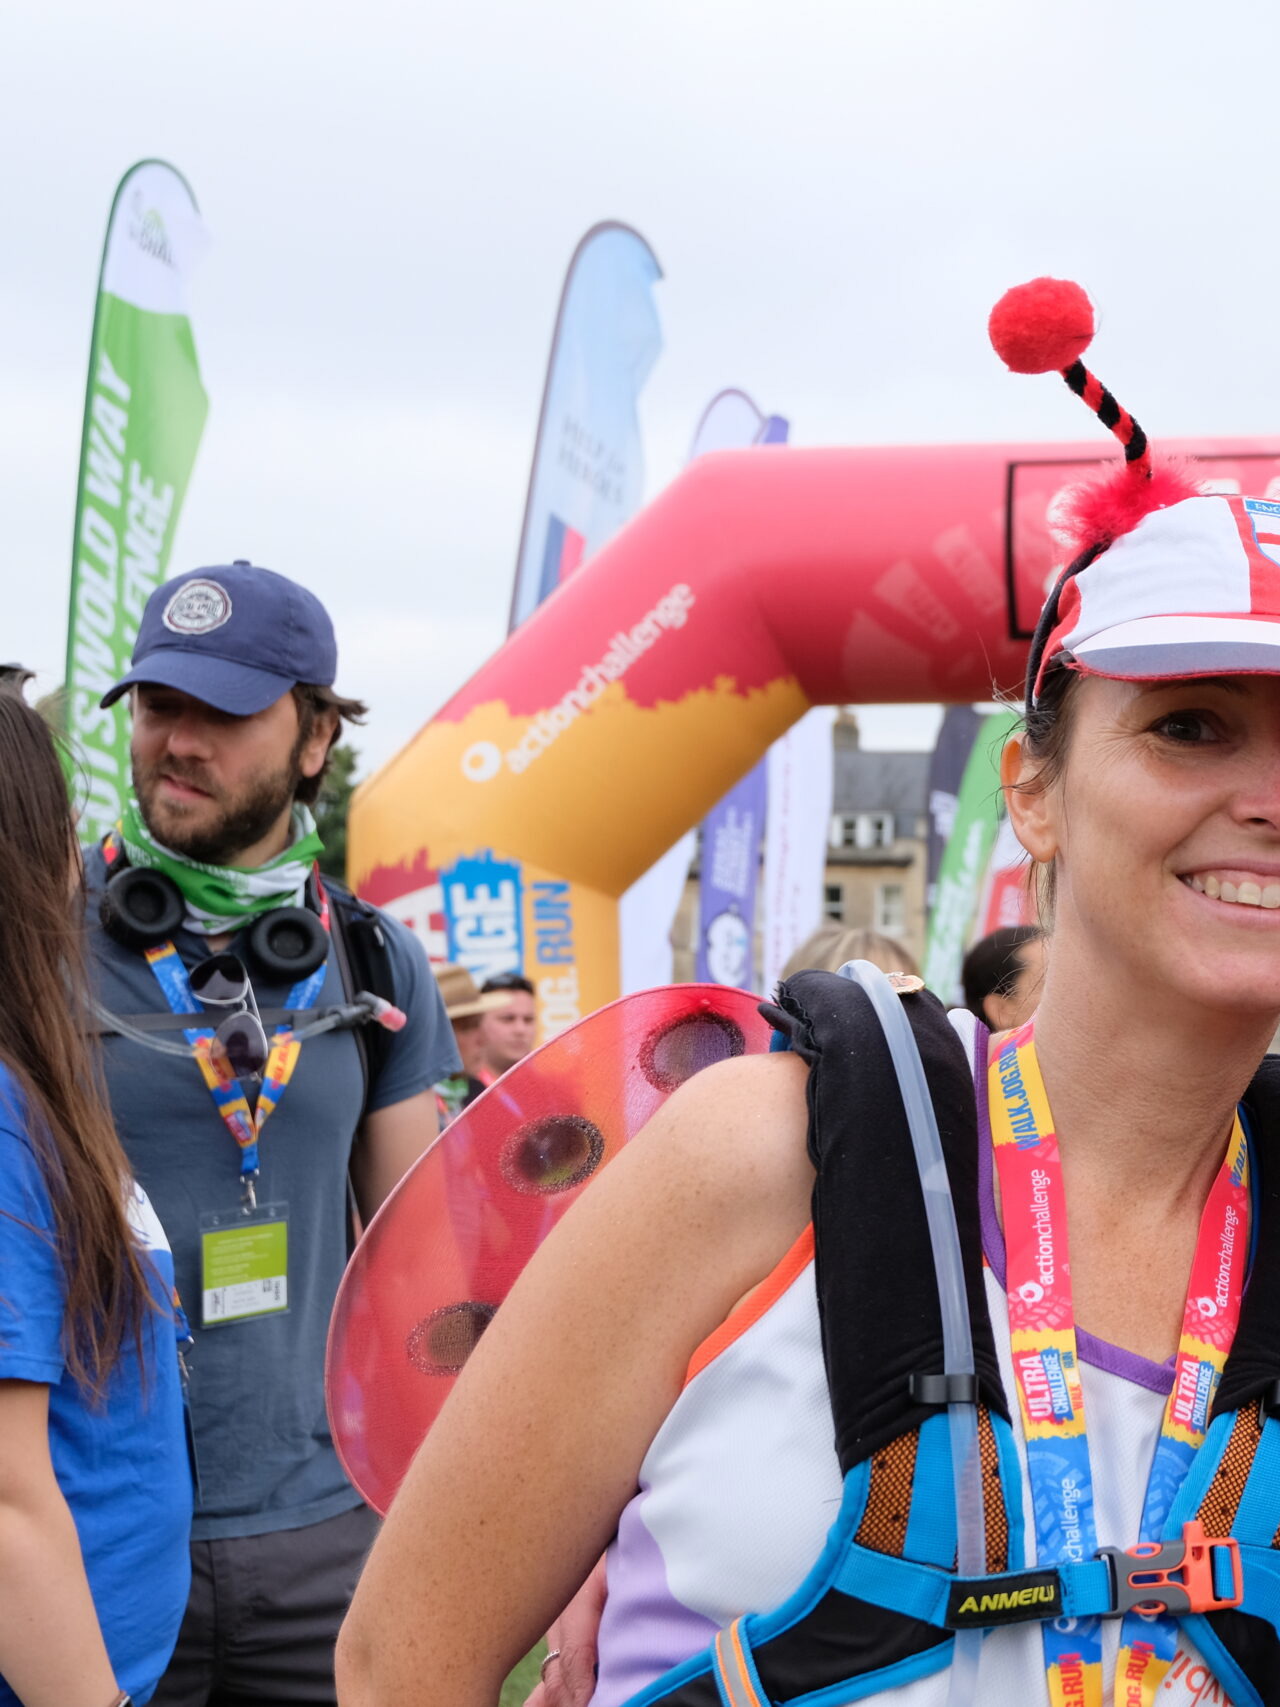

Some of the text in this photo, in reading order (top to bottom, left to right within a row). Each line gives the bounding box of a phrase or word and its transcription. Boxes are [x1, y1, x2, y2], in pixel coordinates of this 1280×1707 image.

[84, 349, 131, 508] WAY
[506, 583, 696, 774] actionchallenge
[1030, 1169, 1054, 1286] actionchallenge
[1215, 1205, 1239, 1308] actionchallenge
[1019, 1354, 1052, 1417] ULTRA
[1042, 1353, 1070, 1415] CHALLENGE
[1174, 1360, 1200, 1421] ULTRA
[1192, 1365, 1212, 1426] CHALLENGE
